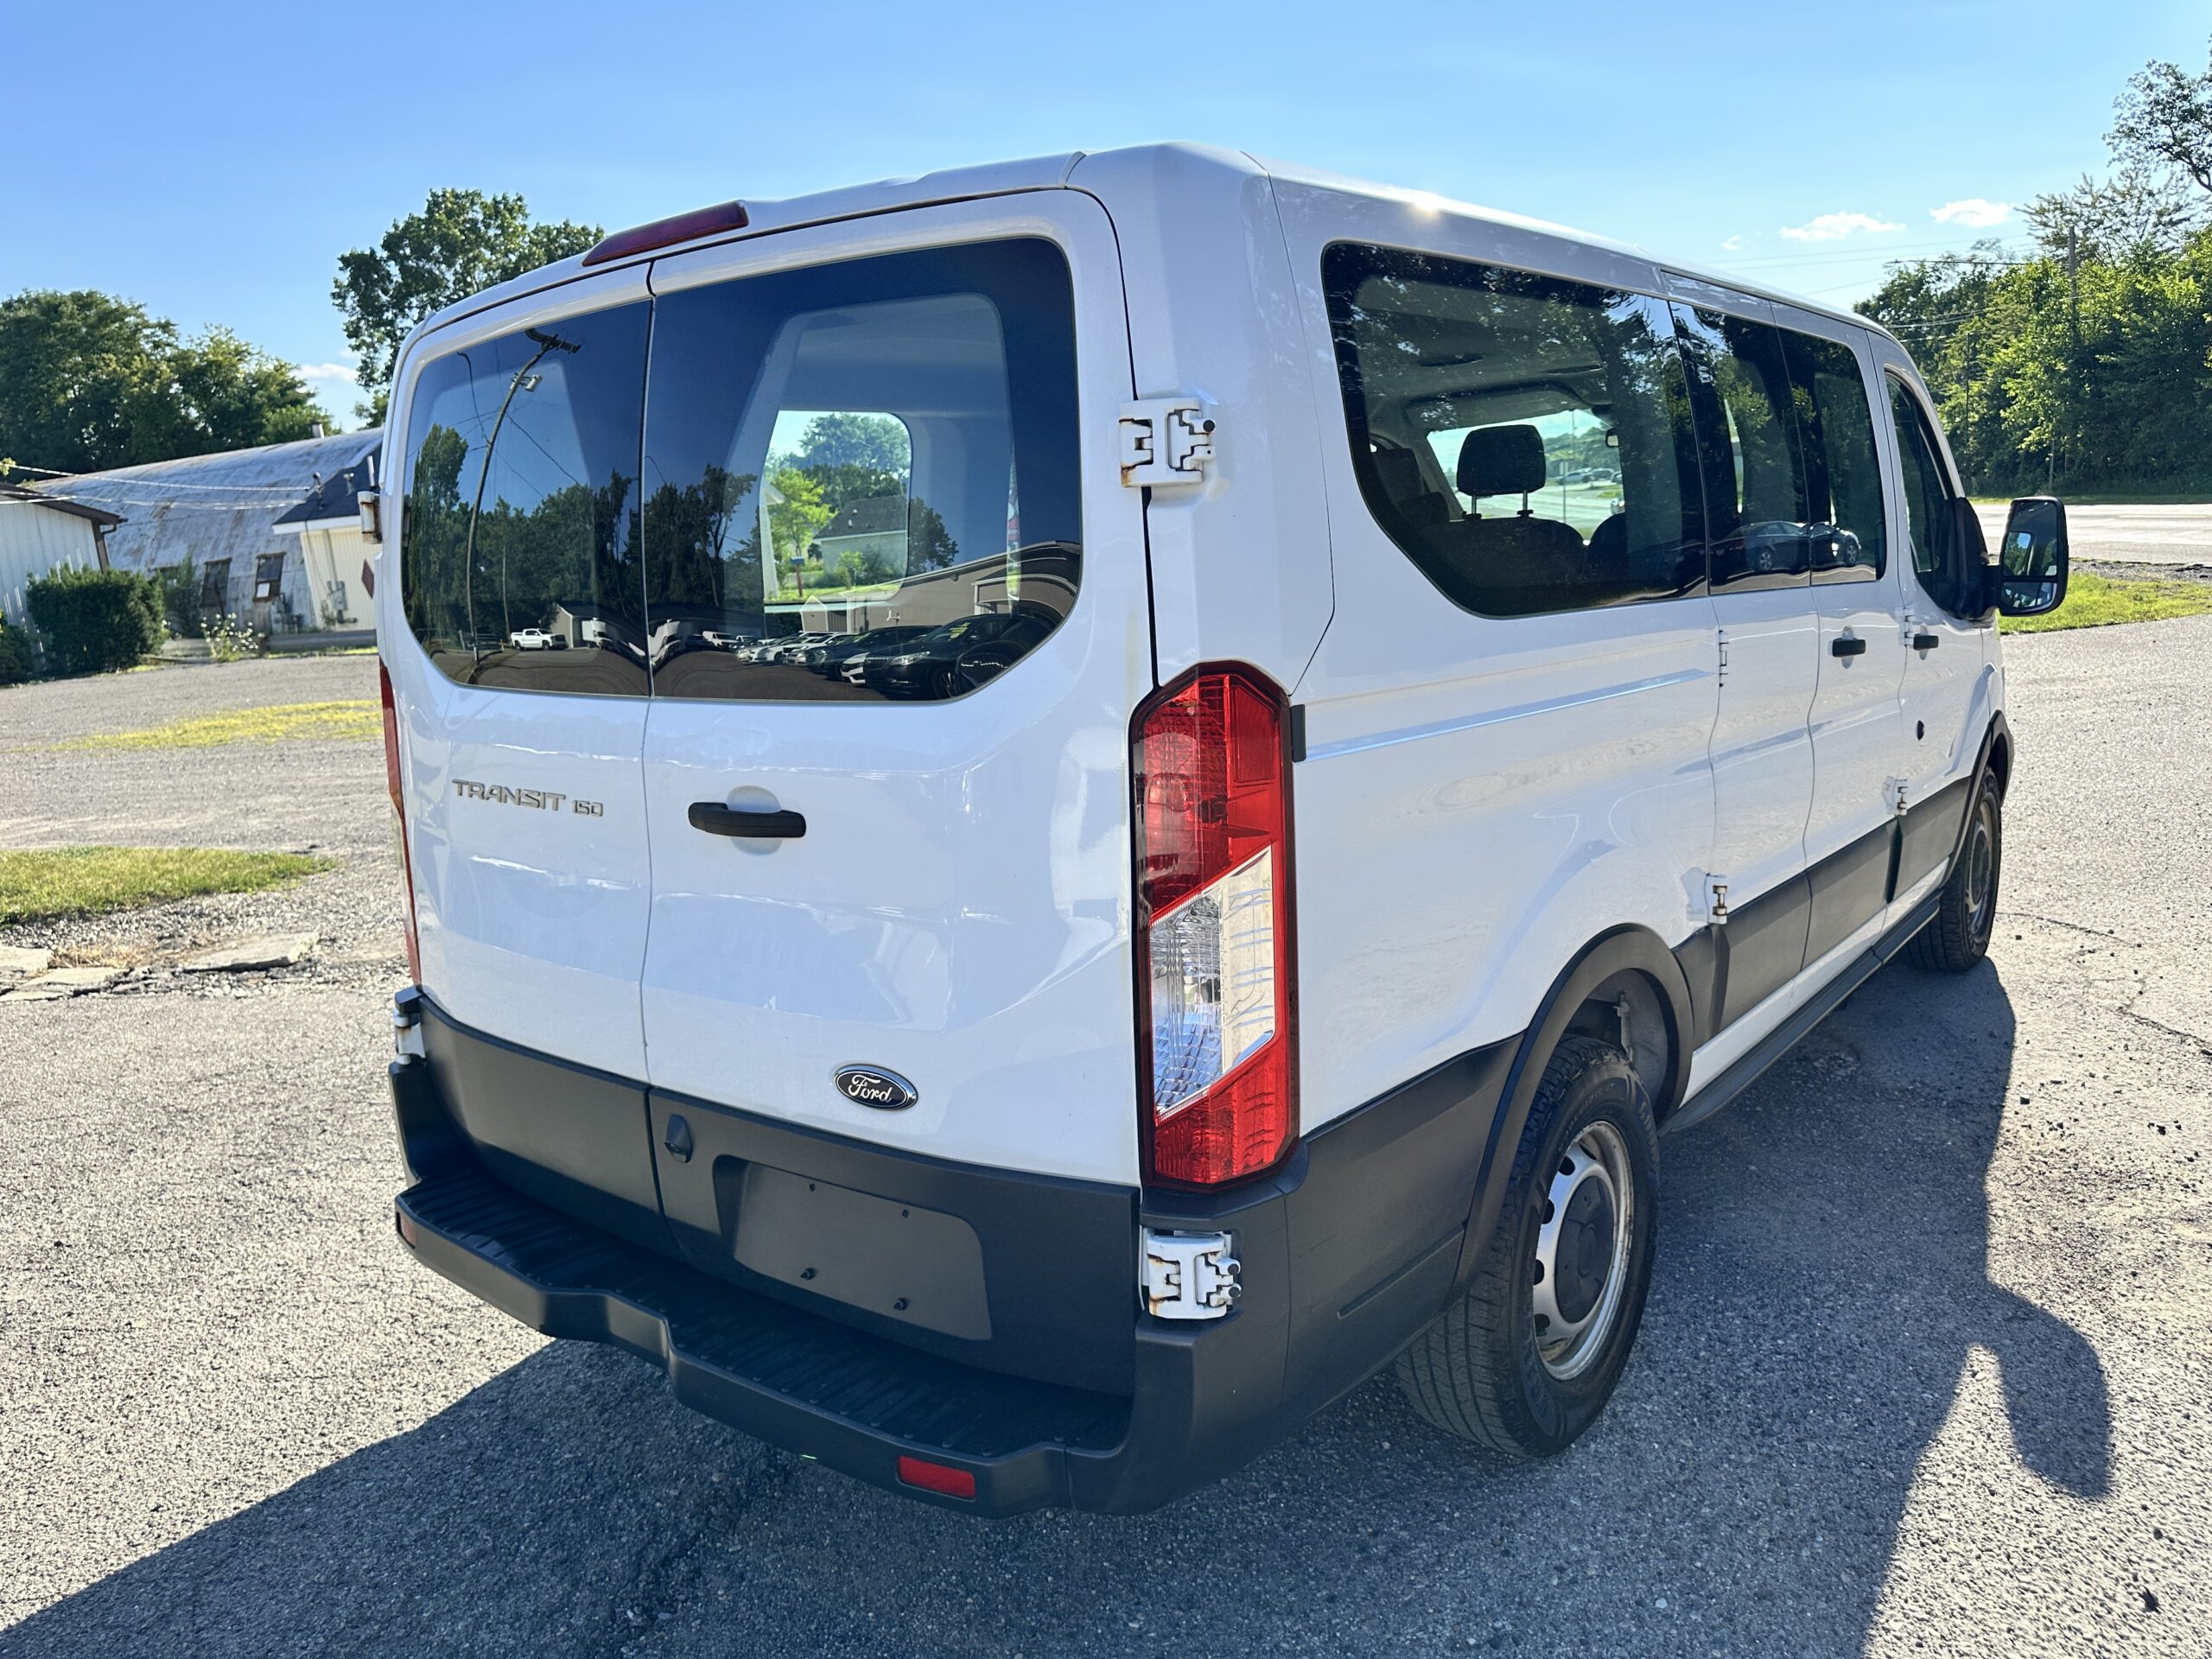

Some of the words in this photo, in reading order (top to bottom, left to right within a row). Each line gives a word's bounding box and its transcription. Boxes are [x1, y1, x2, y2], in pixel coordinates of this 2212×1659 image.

[452, 779, 566, 811] TRANSIT
[572, 799, 603, 817] 150
[849, 1074, 893, 1103] Ford
